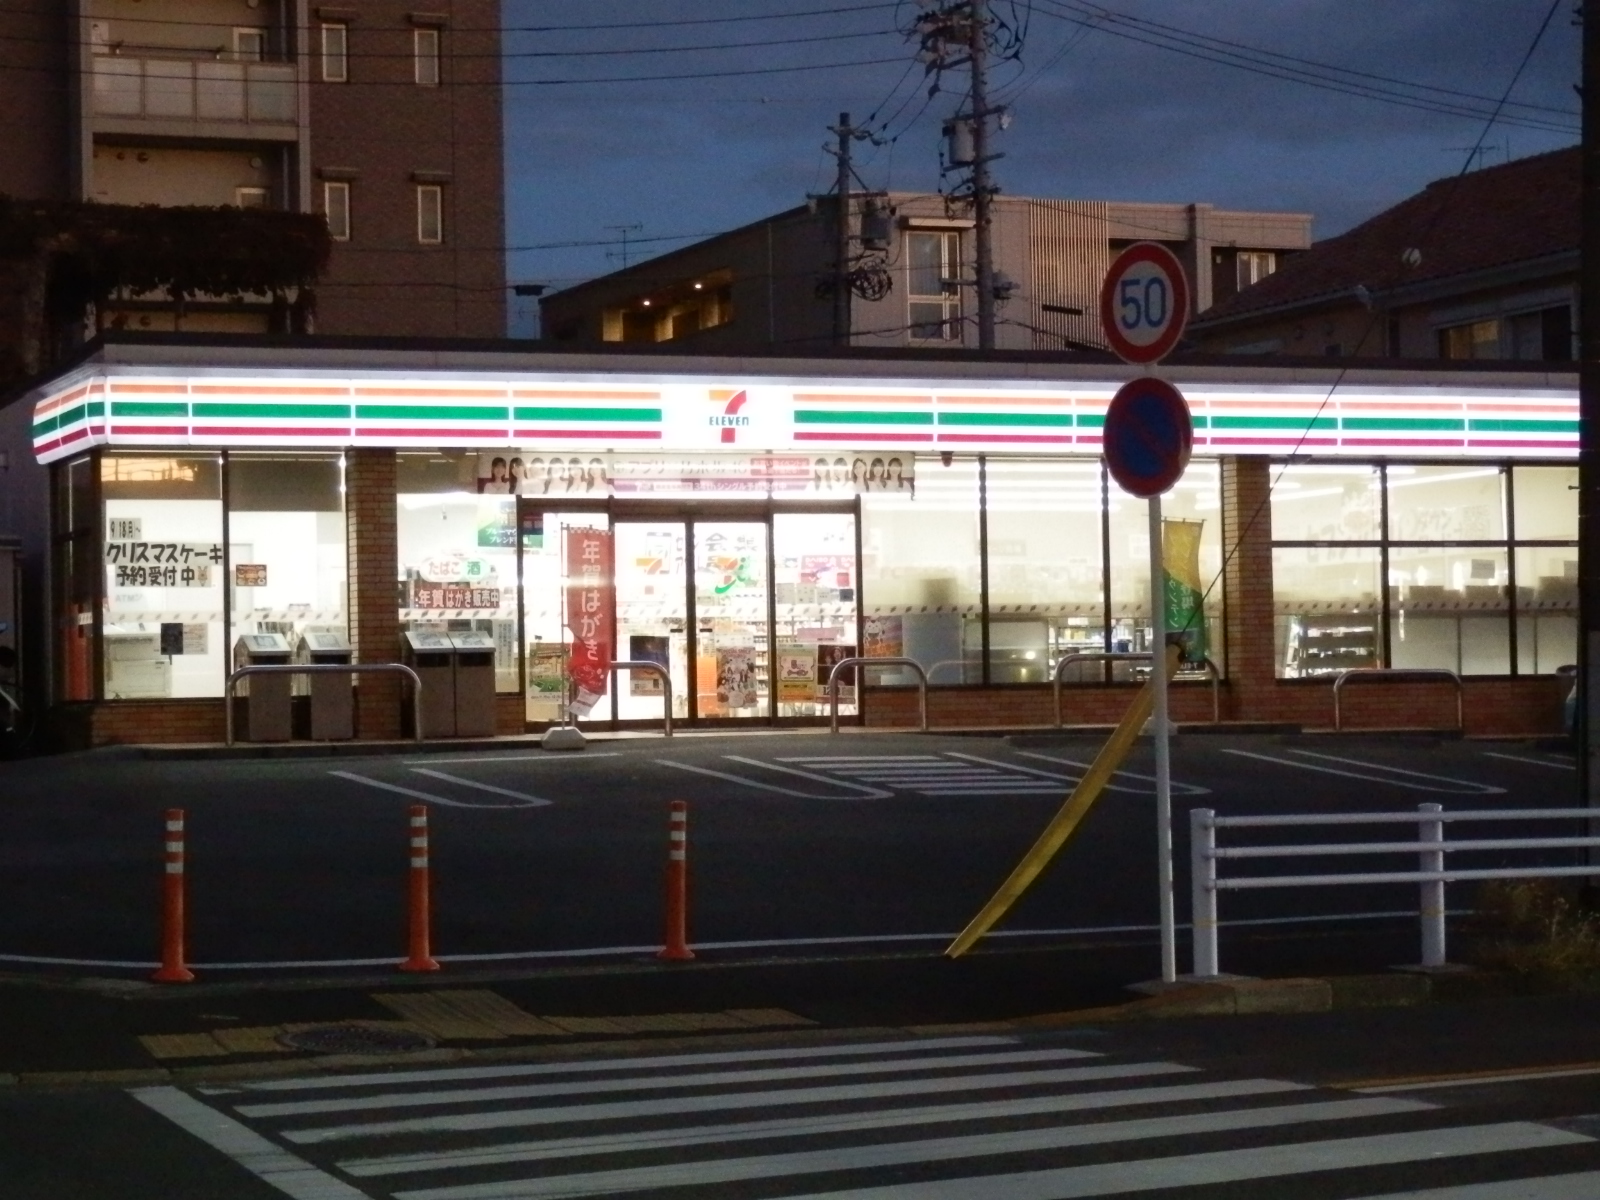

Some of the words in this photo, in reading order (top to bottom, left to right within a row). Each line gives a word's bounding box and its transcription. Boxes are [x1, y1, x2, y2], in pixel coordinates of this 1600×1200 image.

[1120, 277, 1167, 330] 50
[708, 390, 747, 443] 7
[106, 542, 224, 565] クリスマスケーキ
[116, 565, 196, 587] 予約受付中
[428, 561, 461, 576] たばこ
[467, 561, 481, 576] 酒
[418, 589, 499, 608] 年賀はがき販売中
[581, 539, 602, 662] 年賀はがき
